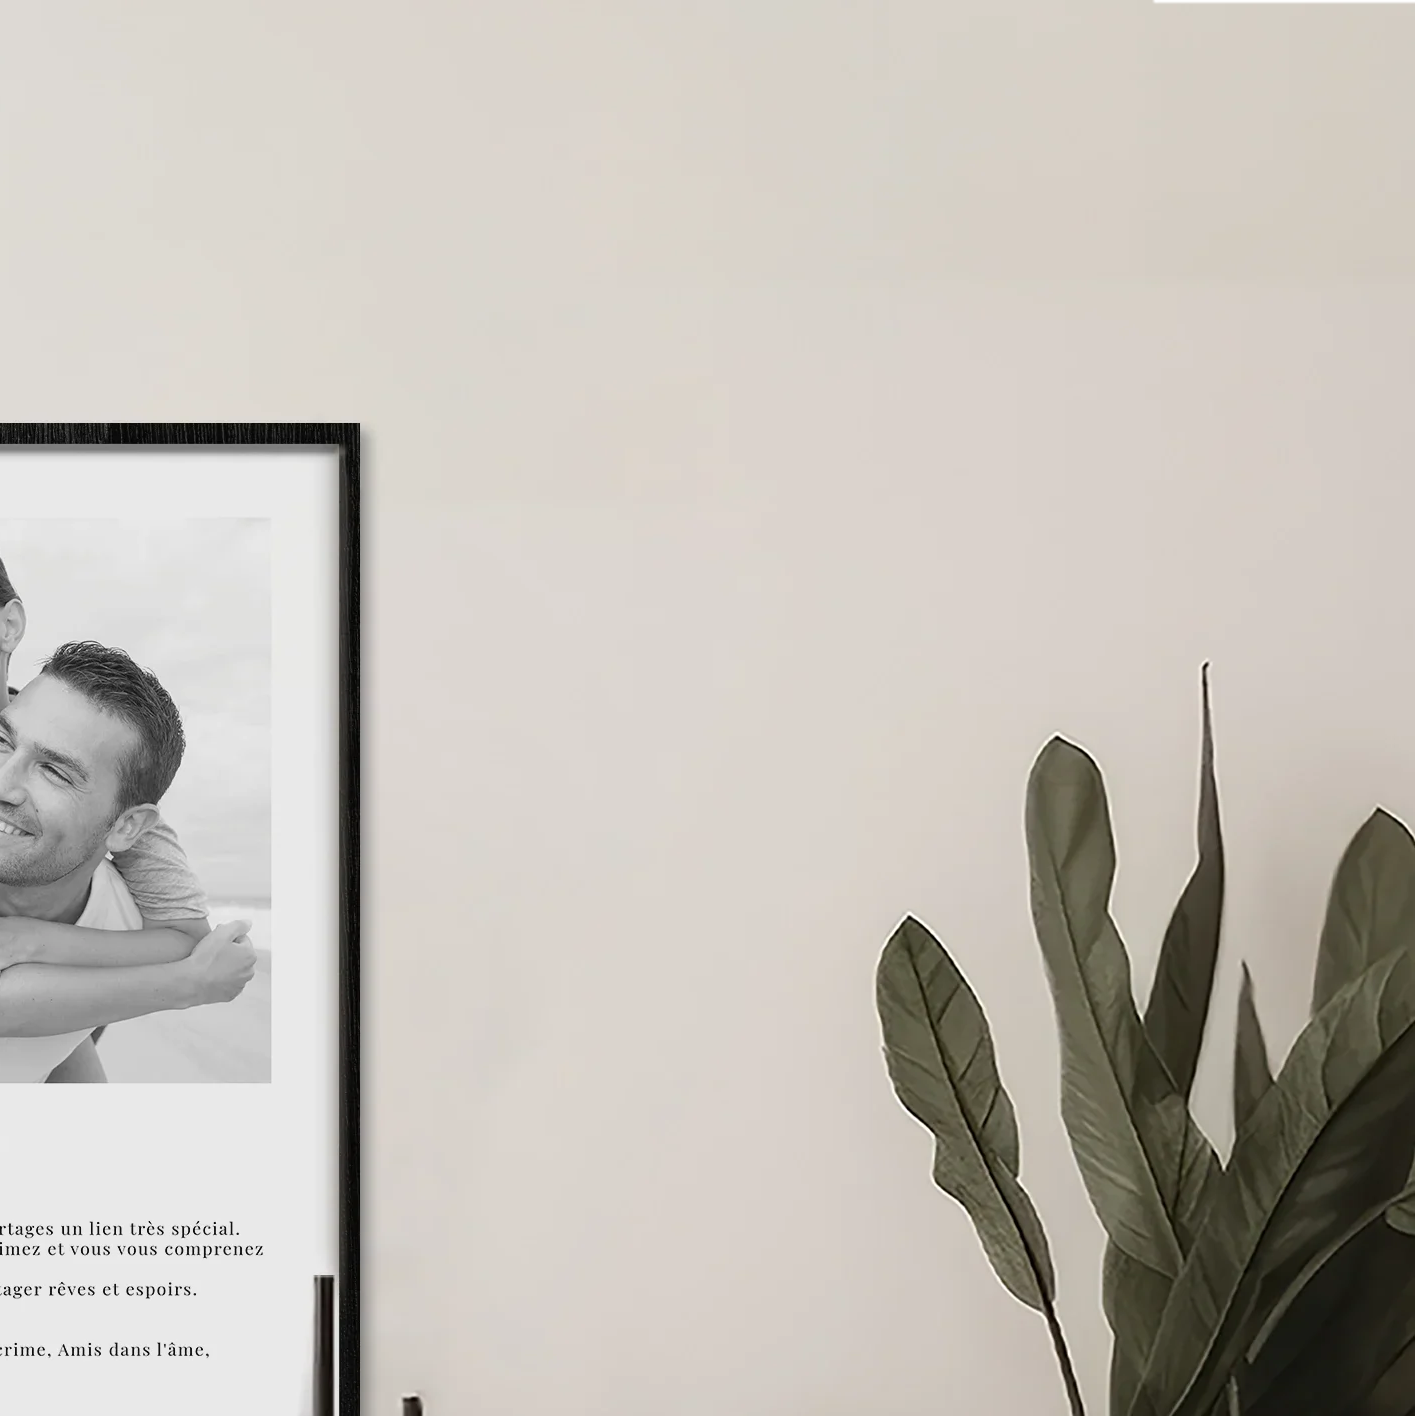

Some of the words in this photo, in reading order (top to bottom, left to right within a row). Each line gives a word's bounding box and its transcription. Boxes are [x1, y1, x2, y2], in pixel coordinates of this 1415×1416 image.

[60, 1224, 83, 1236] un
[89, 1220, 124, 1236] lien
[130, 1220, 165, 1236] très
[171, 1220, 240, 1239] spécial.
[47, 1242, 66, 1257] et
[69, 1245, 111, 1257] vous
[116, 1245, 158, 1257] vous
[164, 1245, 264, 1259] comprenez
[48, 1281, 96, 1297] rêves
[102, 1283, 120, 1297] et
[125, 1281, 197, 1300] espoirs.
[57, 1342, 102, 1357] Amis
[108, 1341, 151, 1357] dans
[156, 1341, 210, 1359] l'âme,
